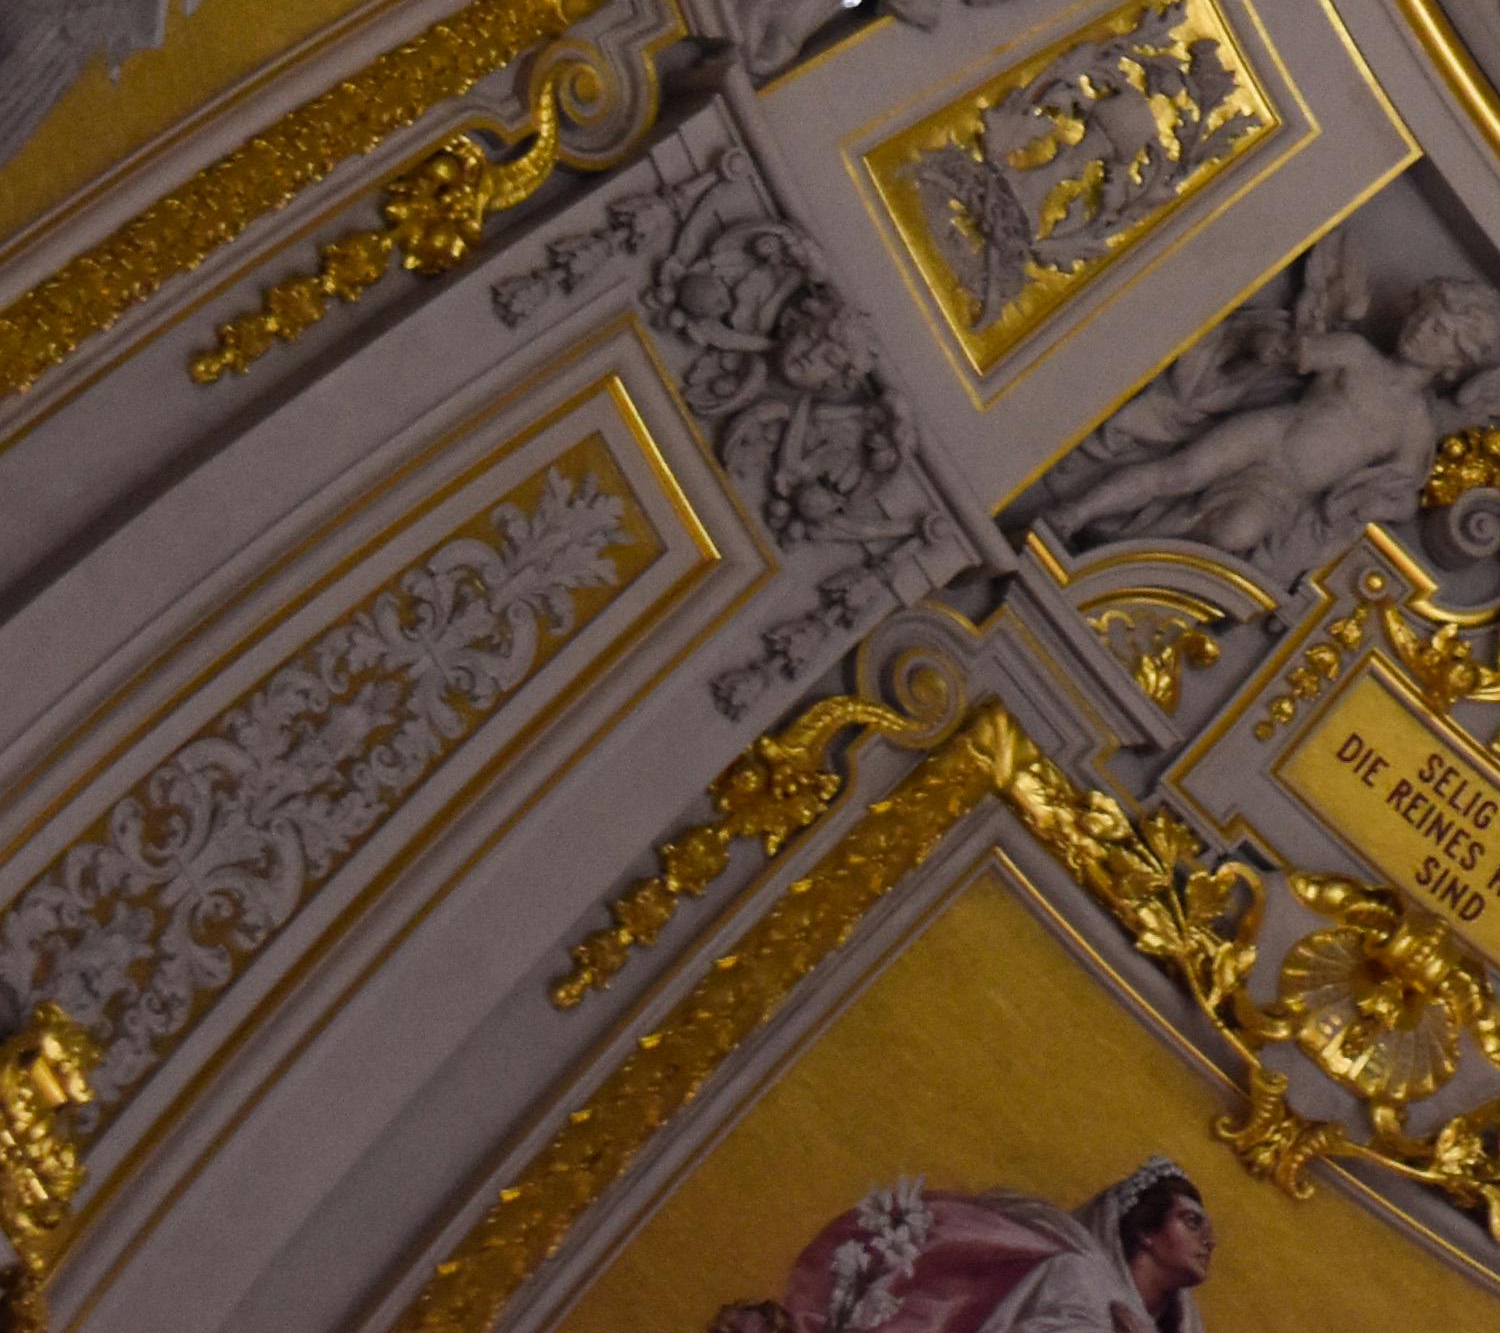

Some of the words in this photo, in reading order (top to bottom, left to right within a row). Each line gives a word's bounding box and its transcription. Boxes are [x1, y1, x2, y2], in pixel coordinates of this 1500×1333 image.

[1336, 733, 1390, 788] DIE
[1386, 779, 1485, 872] REINES
[1418, 753, 1498, 829] SELIG
[1415, 855, 1486, 923] SIND
